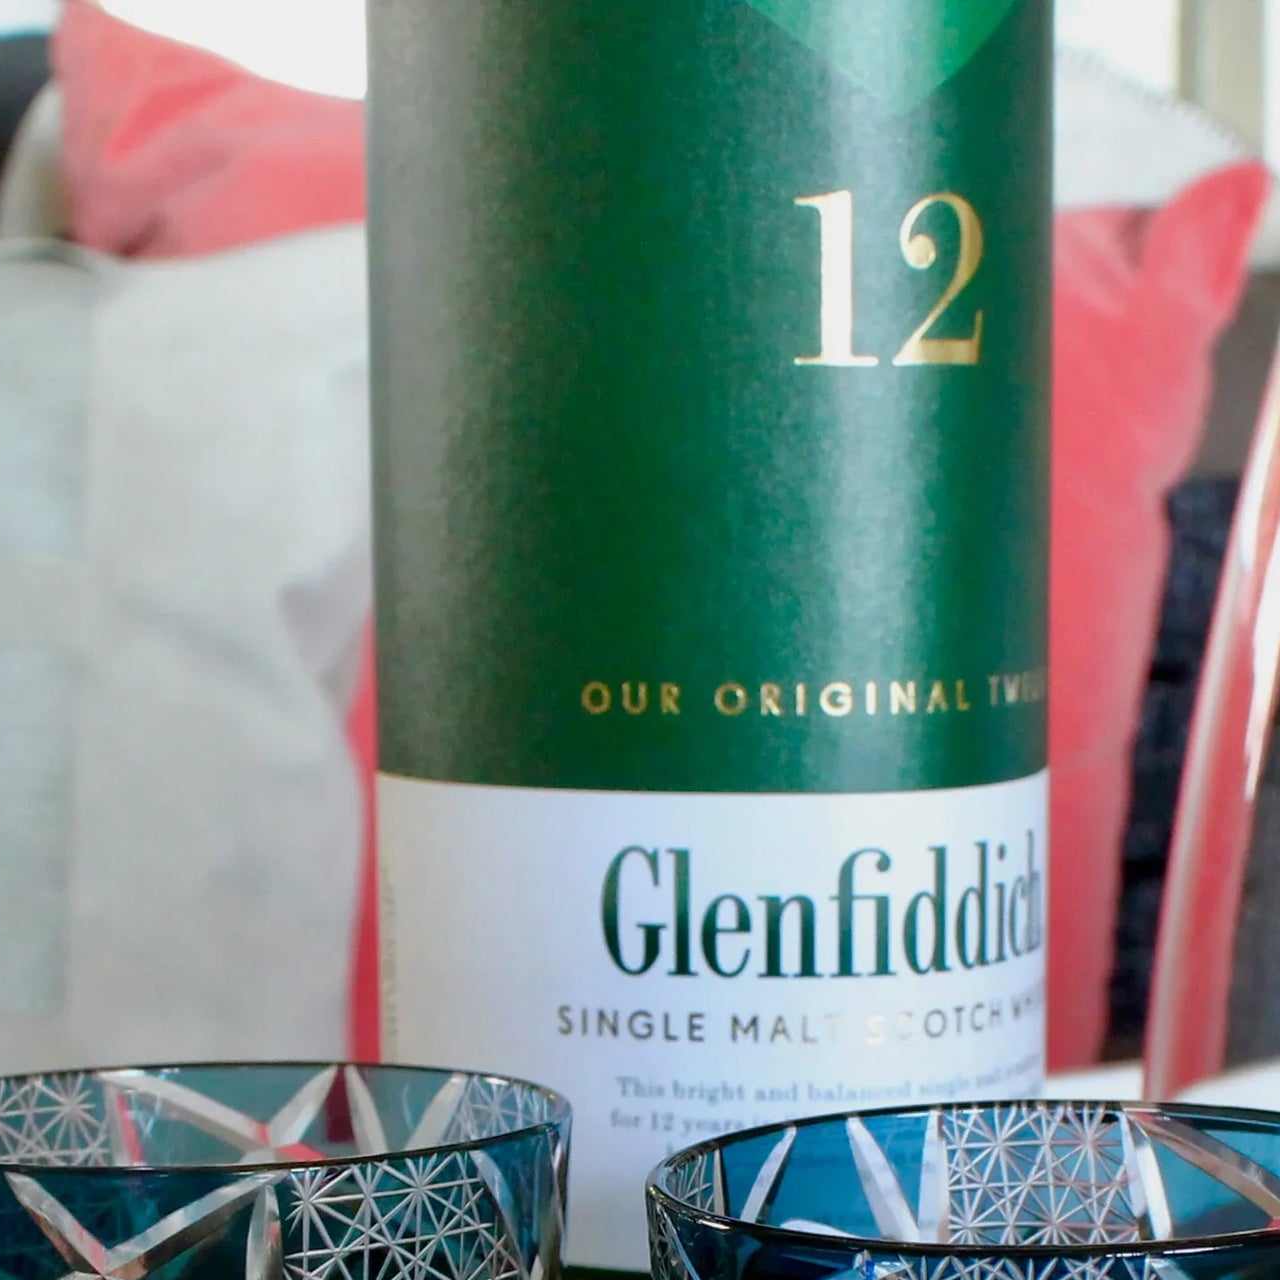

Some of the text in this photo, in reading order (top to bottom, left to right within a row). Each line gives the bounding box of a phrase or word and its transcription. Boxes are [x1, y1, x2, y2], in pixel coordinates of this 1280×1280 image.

[794, 190, 983, 367] 12
[581, 682, 681, 714] OUR
[714, 680, 971, 716] ORIGINAL
[601, 829, 1041, 978] Glenfiddich
[557, 1004, 705, 1042] SINGLE
[730, 1013, 840, 1044] MALT
[866, 998, 1002, 1045] SCOTCH
[616, 1076, 665, 1097] This
[672, 1079, 744, 1105] bright
[754, 1082, 798, 1101] and
[807, 1081, 911, 1101] balanced
[610, 1109, 641, 1128] for
[650, 1112, 673, 1131] 12
[682, 1117, 745, 1138] years
